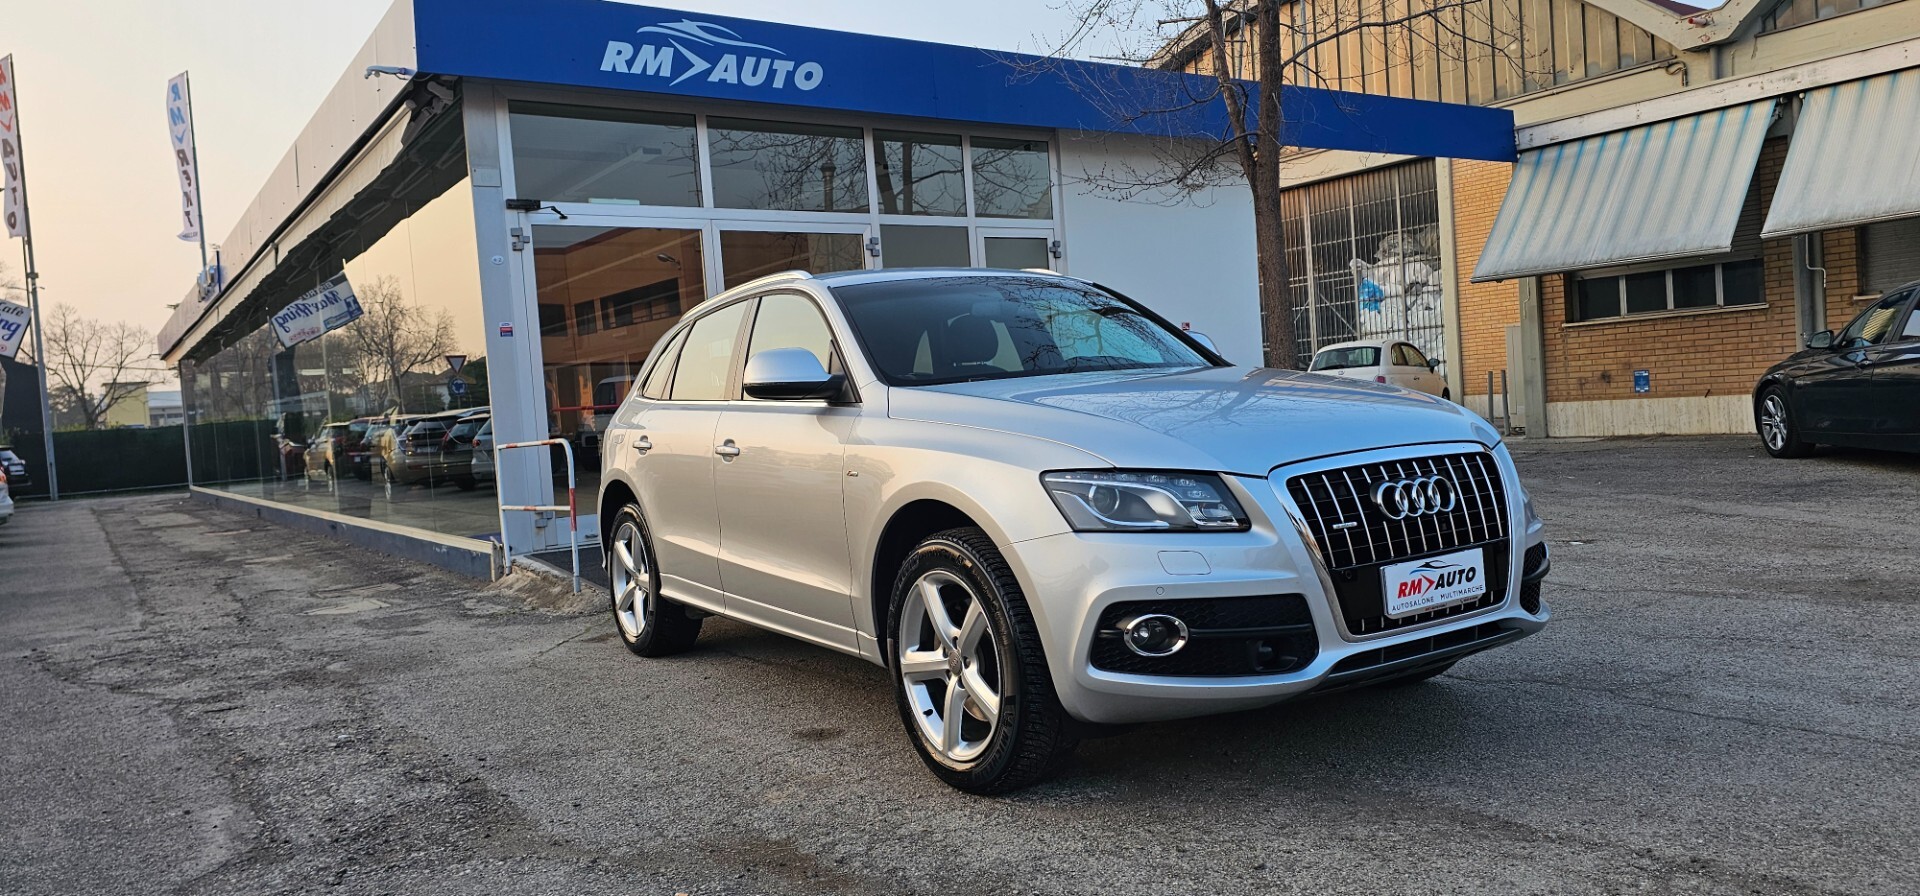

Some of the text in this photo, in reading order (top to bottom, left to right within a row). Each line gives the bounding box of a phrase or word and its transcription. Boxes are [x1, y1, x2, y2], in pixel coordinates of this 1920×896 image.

[600, 40, 824, 91] RM AUTO
[1392, 596, 1434, 612] AUTOSALONE
[1440, 584, 1483, 600] MULTIMARCHE
[1397, 566, 1476, 599] RM AUTO
